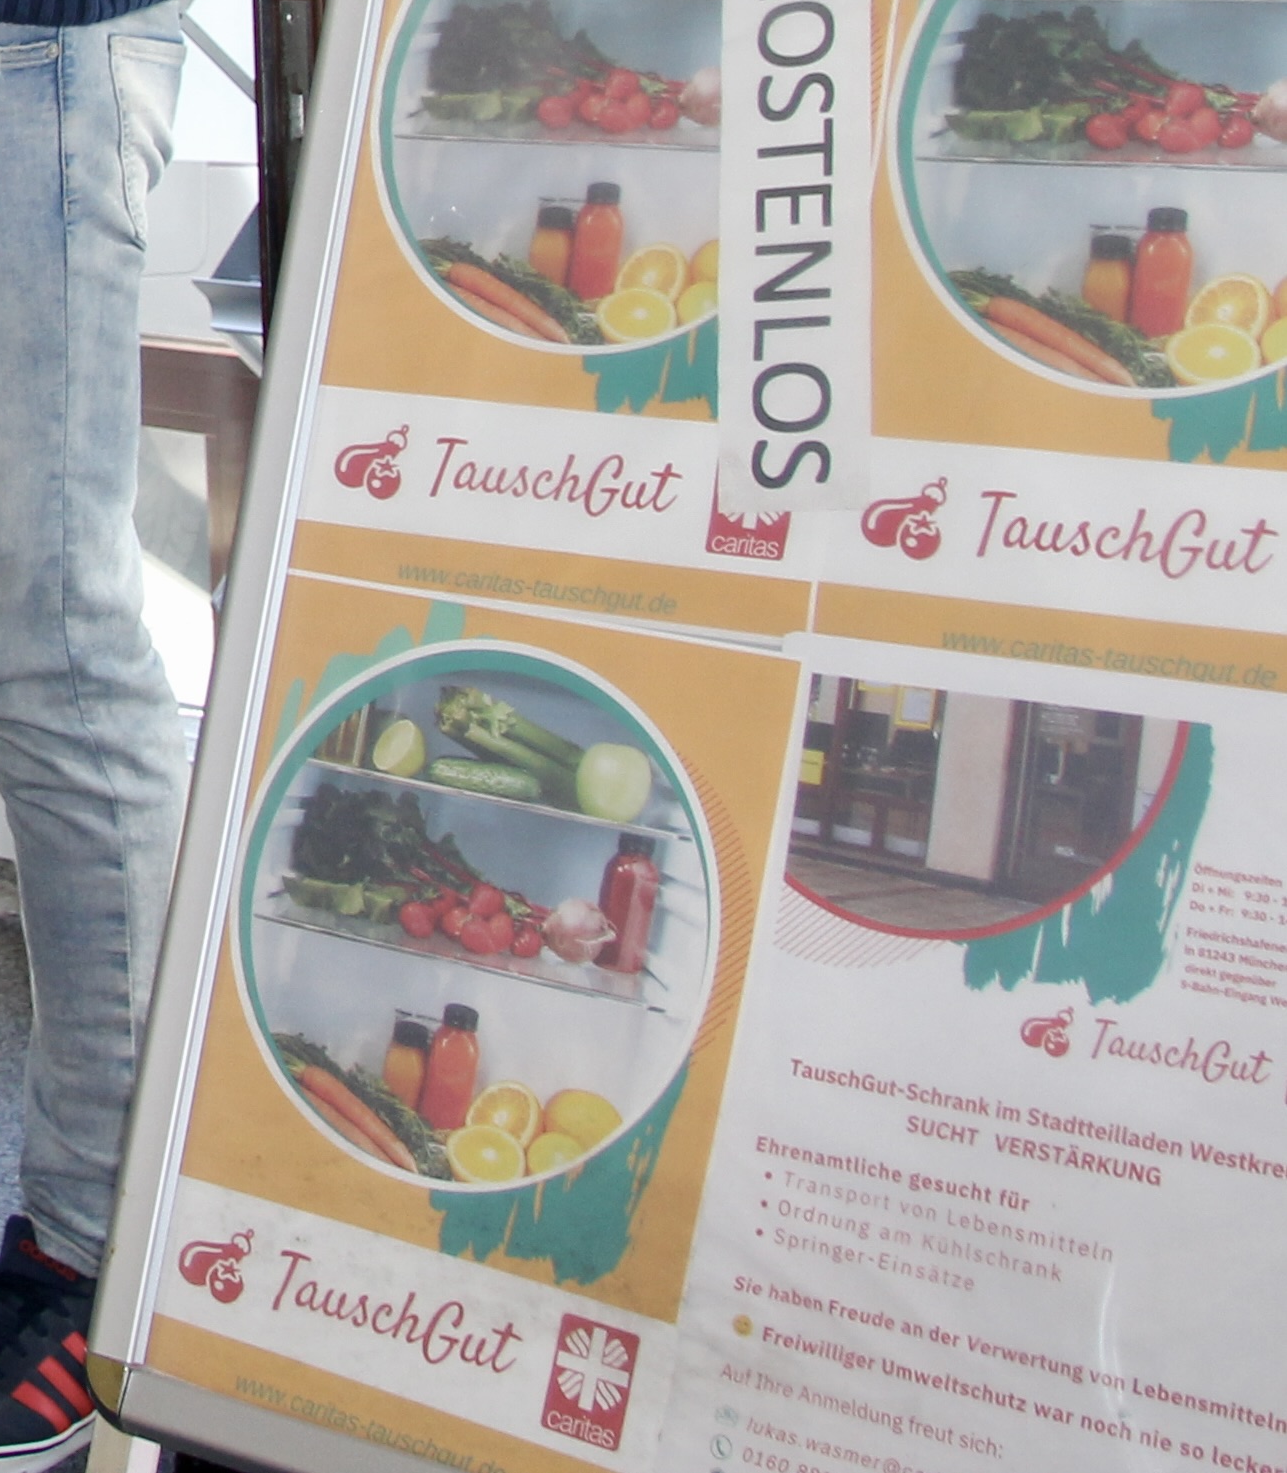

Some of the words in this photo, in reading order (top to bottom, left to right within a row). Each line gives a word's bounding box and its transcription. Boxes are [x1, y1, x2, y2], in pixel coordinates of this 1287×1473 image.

[429, 436, 683, 518] TauschGut
[710, 532, 780, 559] caritas
[975, 489, 1279, 580] TauschGut
[397, 561, 678, 616] www.caritas-tauschgut.de
[941, 630, 1279, 690] www.caritas-tauschgut.de
[1241, 908, 1268, 922] 9:30
[1244, 890, 1271, 904] 9:30
[1088, 1017, 1272, 1084] TauschGut
[790, 1057, 991, 1117] TauschGut-Schrank
[995, 1100, 1022, 1123] im
[1026, 1106, 1183, 1158] Stadtteilladen
[1189, 1139, 1287, 1180] Westkre
[905, 1114, 979, 1147] SUCHT
[994, 1131, 1162, 1187] VERSTÄRKUNG
[756, 1135, 903, 1184] Ehrenamtliche
[909, 1170, 992, 1205] gesucht
[998, 1186, 1031, 1212] für
[777, 1198, 871, 1241] Ordnung
[879, 1224, 912, 1246] am
[922, 1233, 1064, 1283] Kühlschrank
[783, 1170, 890, 1212] Transport
[900, 1198, 938, 1222] von
[946, 1208, 1115, 1263] Lebensmitteln
[772, 1227, 976, 1292] Springer-Einsätze
[271, 1249, 524, 1374] TauschGut
[733, 1275, 763, 1296] Sie
[768, 1283, 824, 1313] haben
[828, 1298, 896, 1331] Freude
[901, 1320, 924, 1339] an
[929, 1326, 961, 1349] der
[966, 1334, 1084, 1384] Verwertung
[1089, 1369, 1126, 1391] von
[1132, 1376, 1287, 1435] Lebensmitteln
[546, 1409, 616, 1449] caritas
[720, 1362, 753, 1386] Auf
[754, 1370, 794, 1399] Ihre
[797, 1384, 905, 1435] Anmeldung
[907, 1414, 955, 1446] freut
[959, 1430, 1004, 1460] sich:
[761, 1325, 877, 1370] Freiwilliger
[881, 1357, 1028, 1413] Umweltschutz
[1033, 1400, 1075, 1426] war
[1080, 1412, 1133, 1443] noch
[1139, 1429, 1173, 1452] nie
[1179, 1438, 1205, 1461] so
[741, 1446, 791, 1473] 0160
